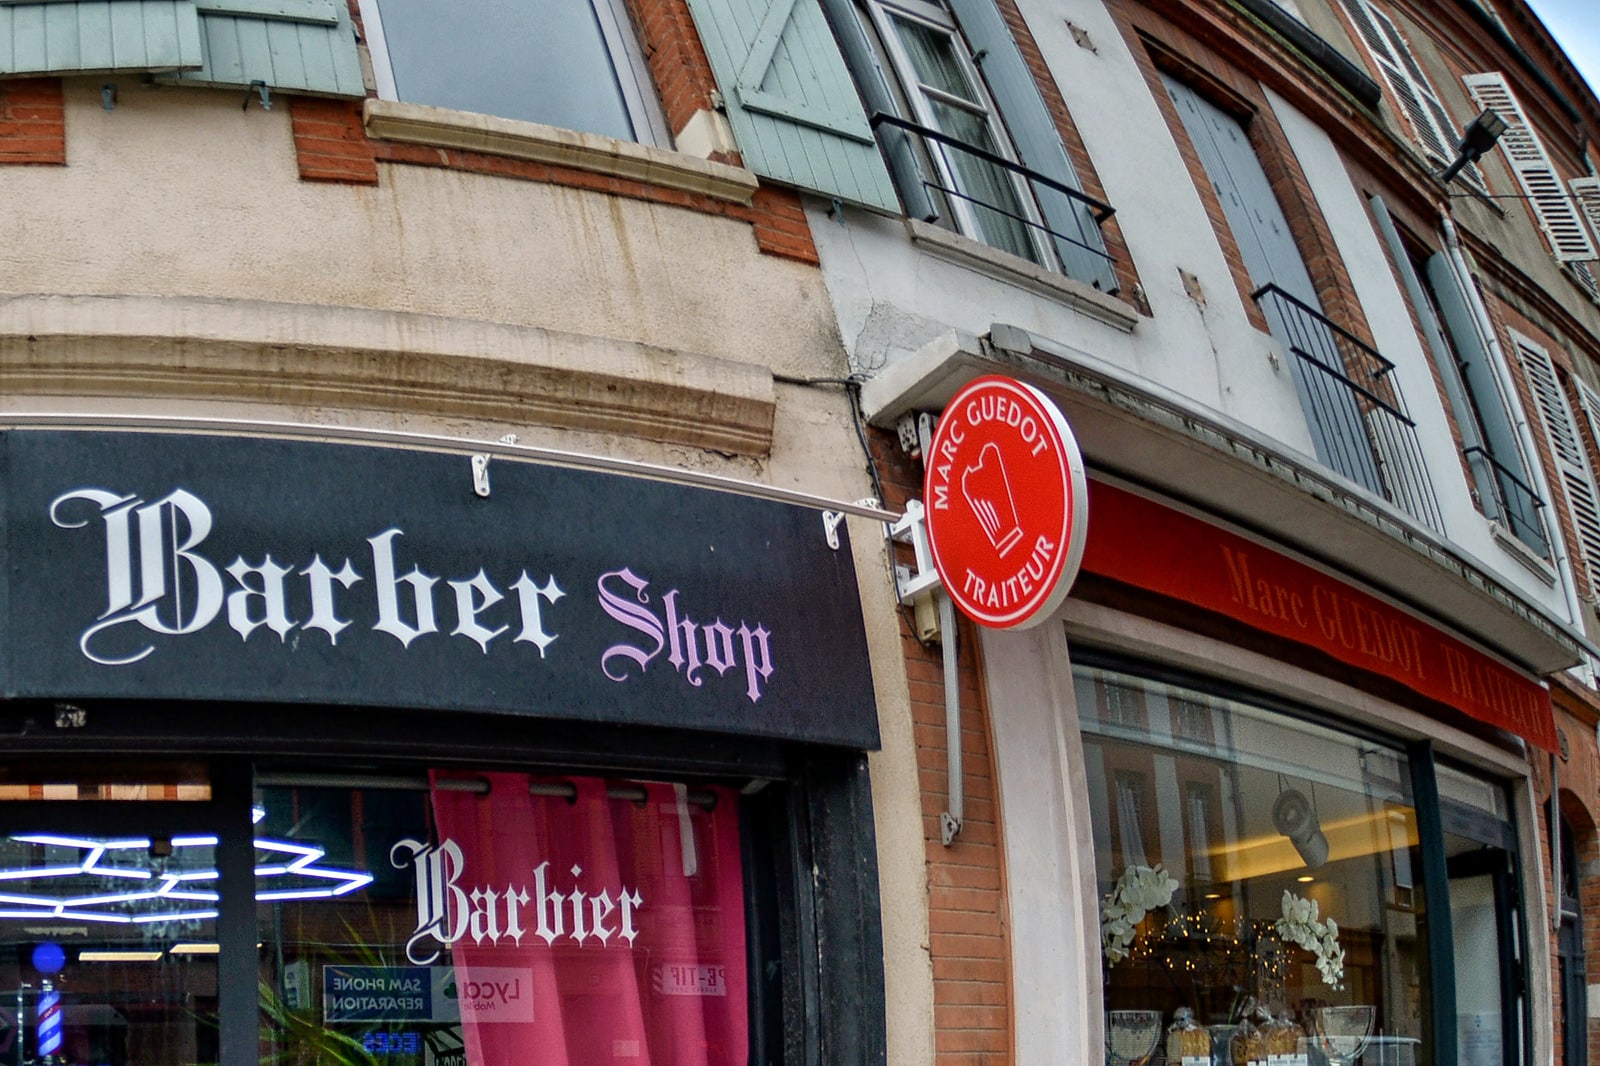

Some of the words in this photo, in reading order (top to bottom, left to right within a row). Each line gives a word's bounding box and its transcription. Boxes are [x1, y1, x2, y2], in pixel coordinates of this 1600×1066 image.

[934, 419, 965, 510] MARC
[966, 395, 1049, 458] GUEDOT
[49, 487, 568, 666] Barber
[598, 567, 775, 704] Shop
[963, 534, 1055, 609] TRAITEUR
[1219, 544, 1308, 629] Marc
[1311, 584, 1427, 681] GUEDOT
[389, 837, 644, 965] Barbier
